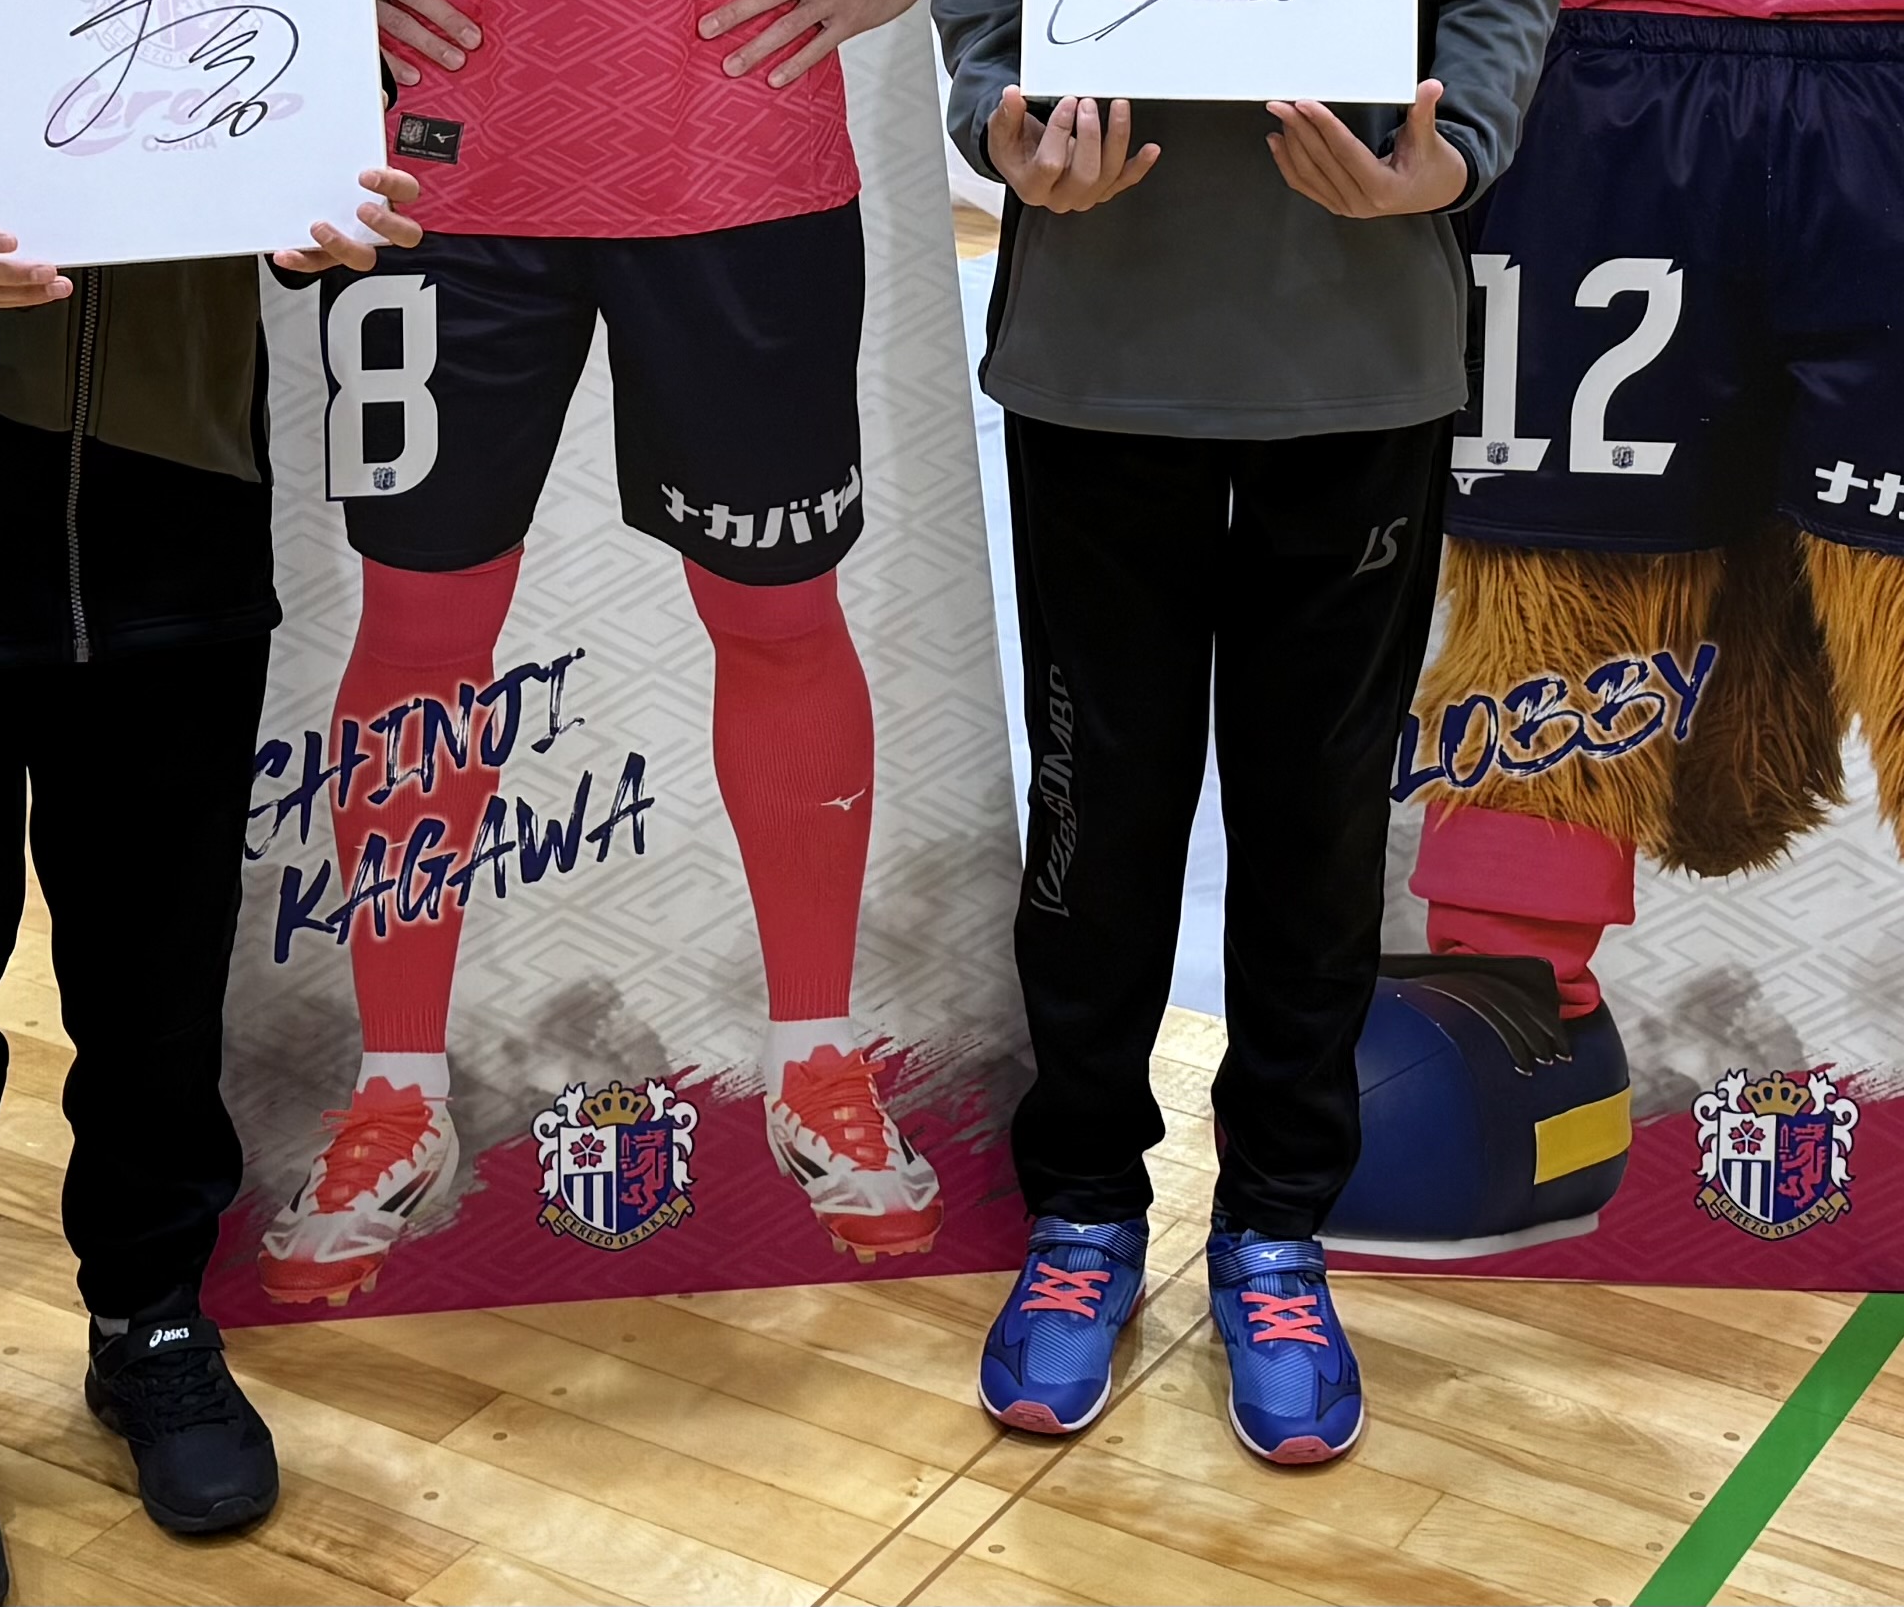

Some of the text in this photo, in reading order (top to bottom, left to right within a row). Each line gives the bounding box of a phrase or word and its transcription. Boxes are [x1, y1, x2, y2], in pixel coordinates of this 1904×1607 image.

[325, 274, 439, 500] 8
[1450, 253, 1685, 476] 12
[243, 647, 587, 860] SHINJI
[1391, 644, 1719, 804] LOBBY
[273, 752, 655, 964] KAGAWA
[563, 1209, 670, 1246] CEREZO OSAKA
[1719, 1199, 1826, 1236] CEREZO OSAKA
